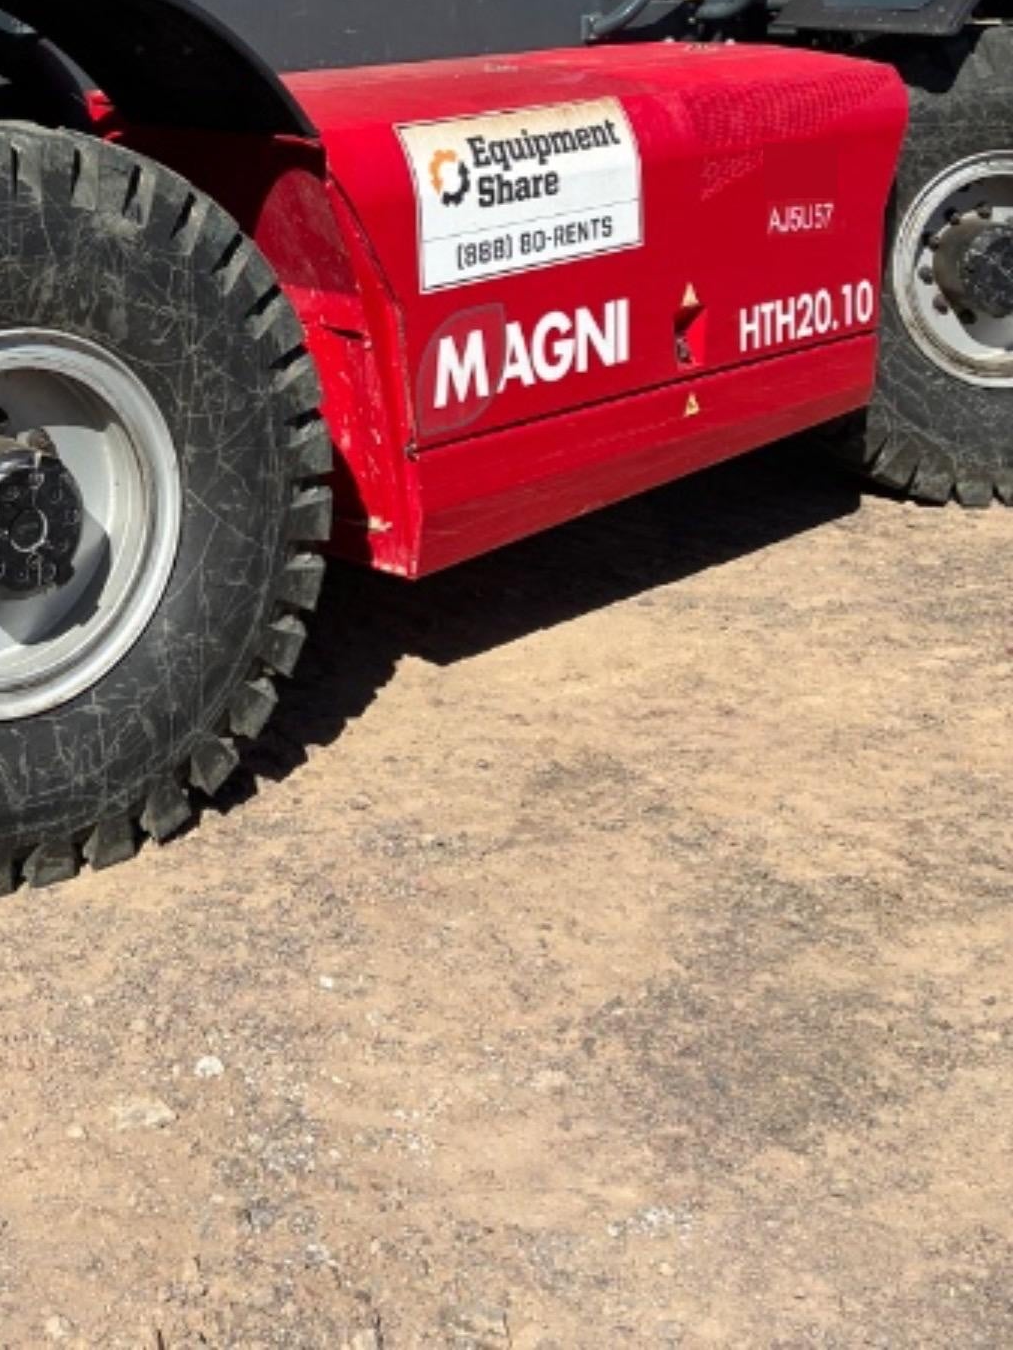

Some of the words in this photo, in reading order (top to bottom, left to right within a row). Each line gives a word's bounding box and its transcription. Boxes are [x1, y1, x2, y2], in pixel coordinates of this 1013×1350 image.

[466, 119, 621, 171] Equipment
[478, 170, 559, 208] Share
[739, 280, 874, 352] HTH20.10
[433, 298, 630, 409] MAGNI
